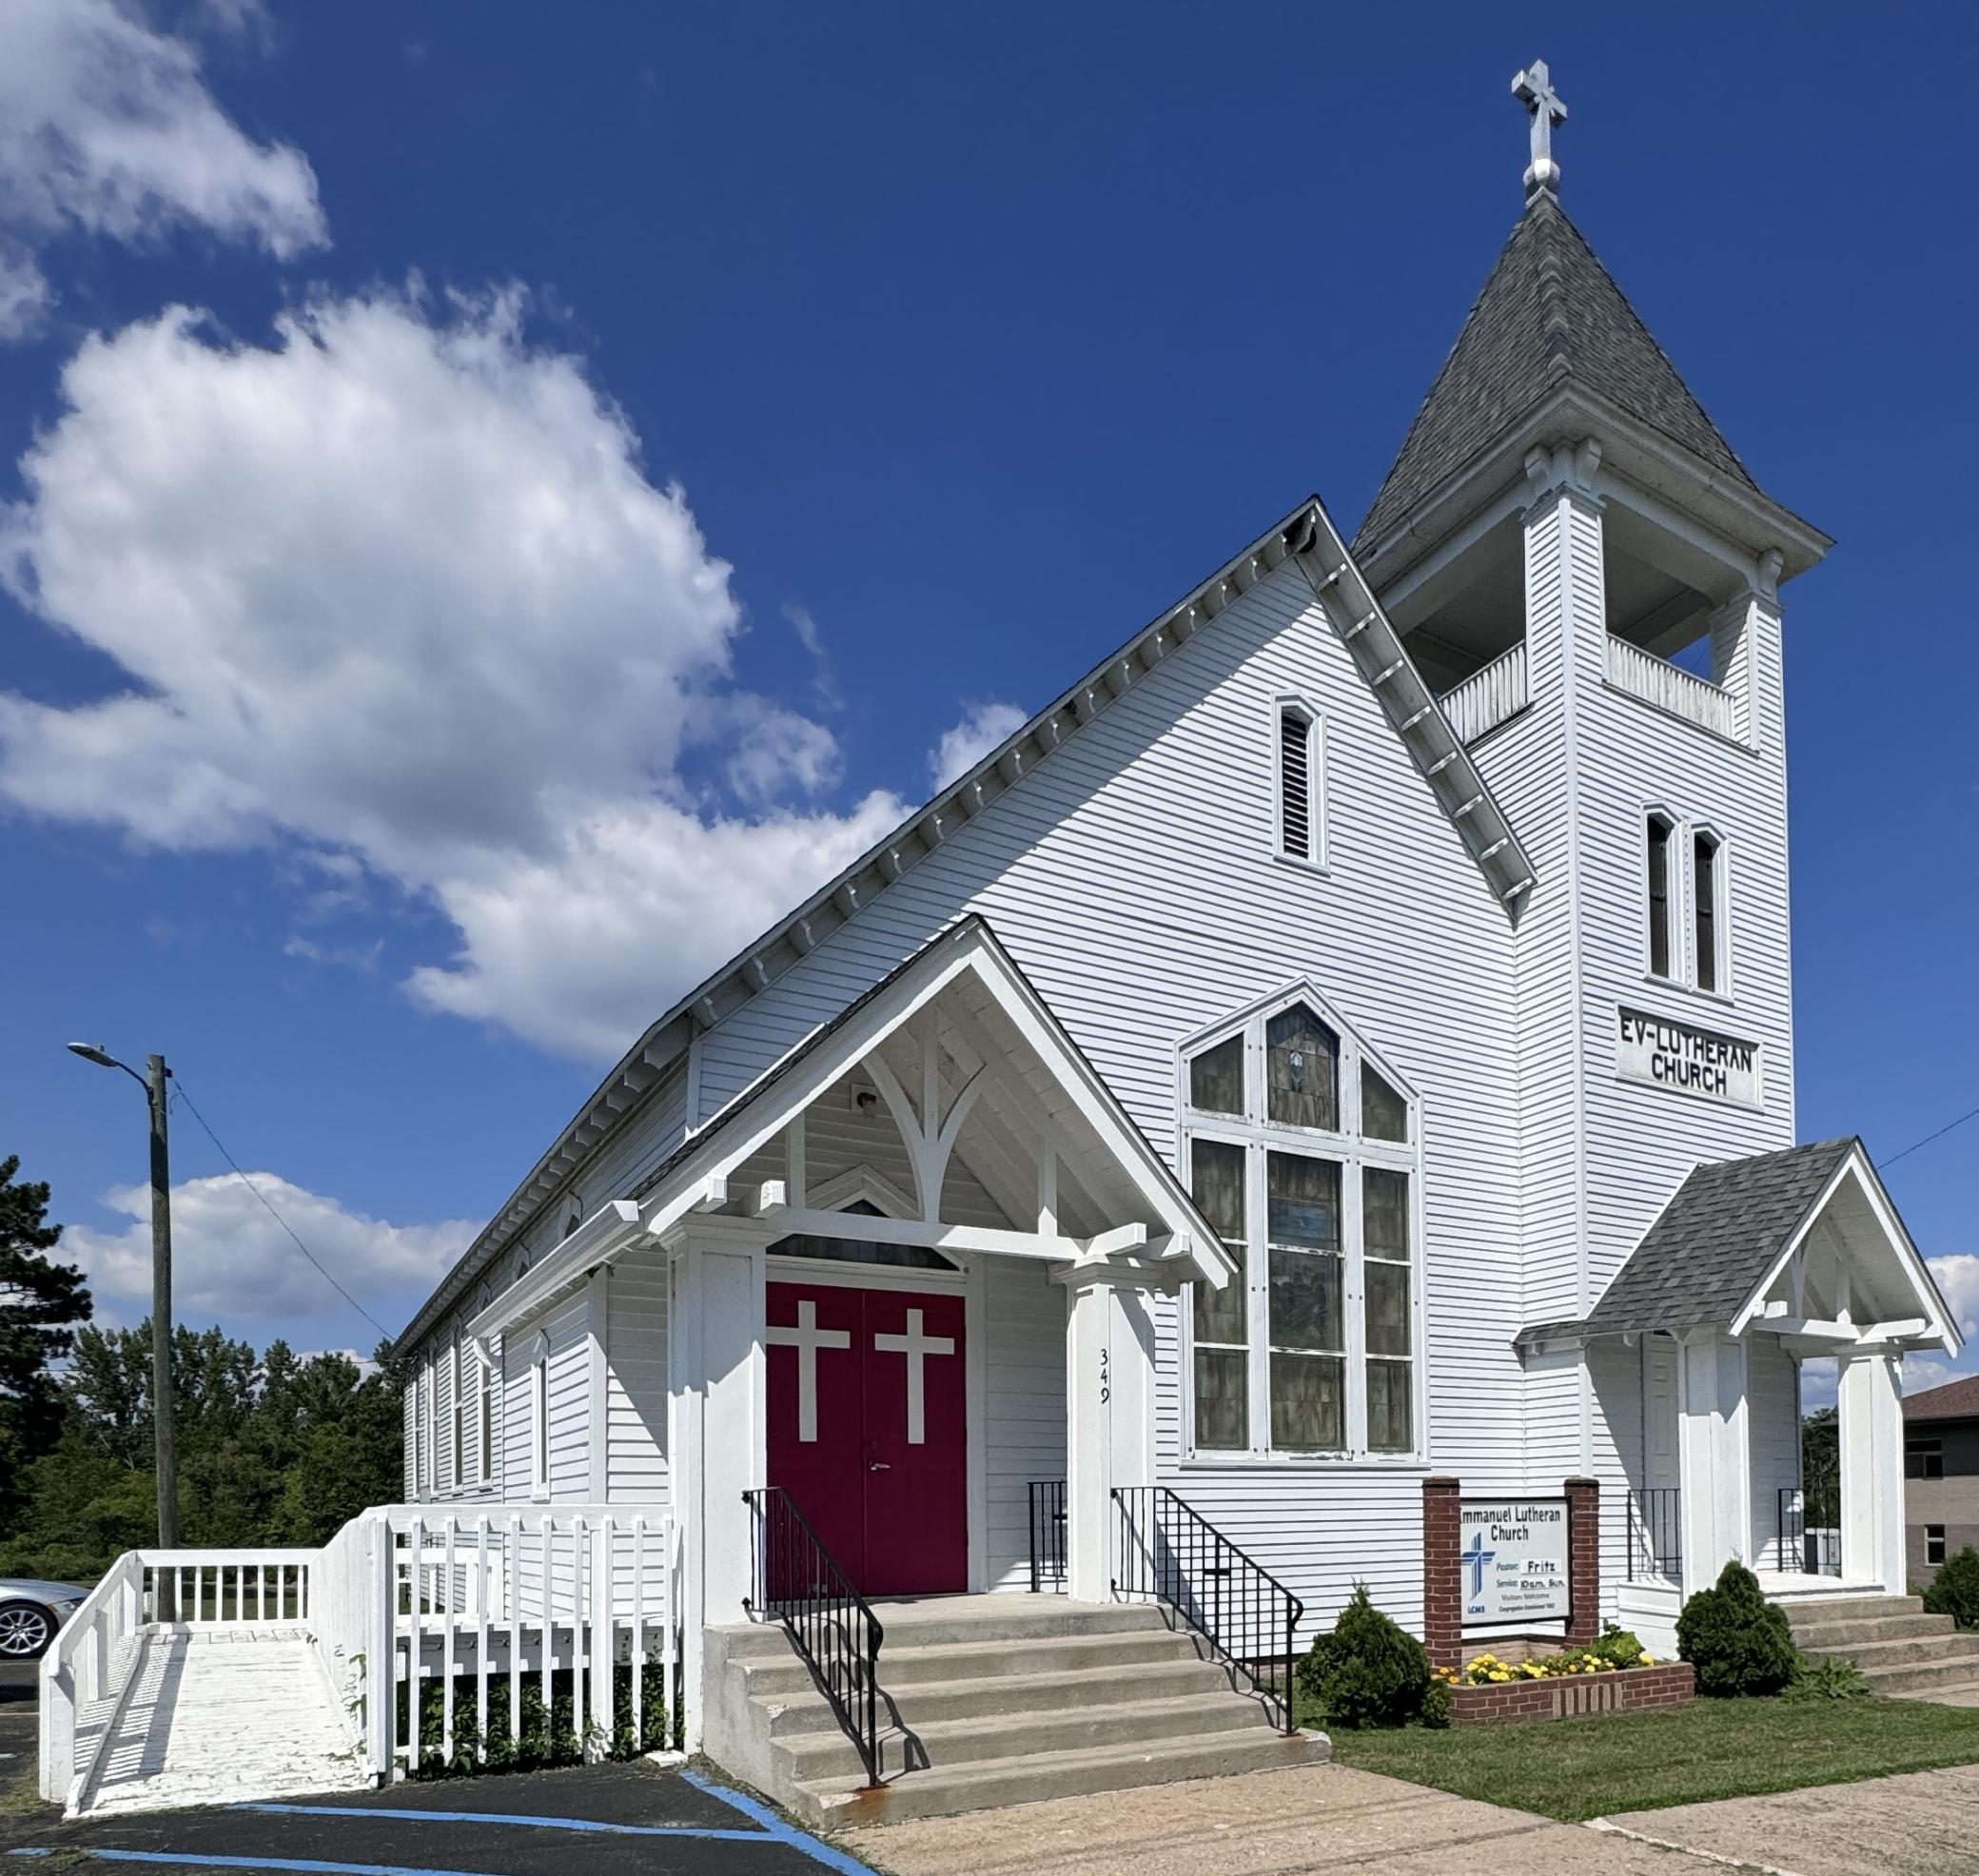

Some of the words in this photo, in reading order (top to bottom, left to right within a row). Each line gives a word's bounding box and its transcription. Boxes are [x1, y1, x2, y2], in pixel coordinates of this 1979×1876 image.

[1620, 1014, 1752, 1073] EV-LUTHERAN
[1652, 1053, 1727, 1096] CHURCH
[1100, 1348, 1110, 1404] 349
[1460, 1506, 1512, 1523] mmanuel
[1516, 1506, 1560, 1522] Lutheran
[1491, 1524, 1529, 1541] Church
[1528, 1561, 1556, 1573] Fritz
